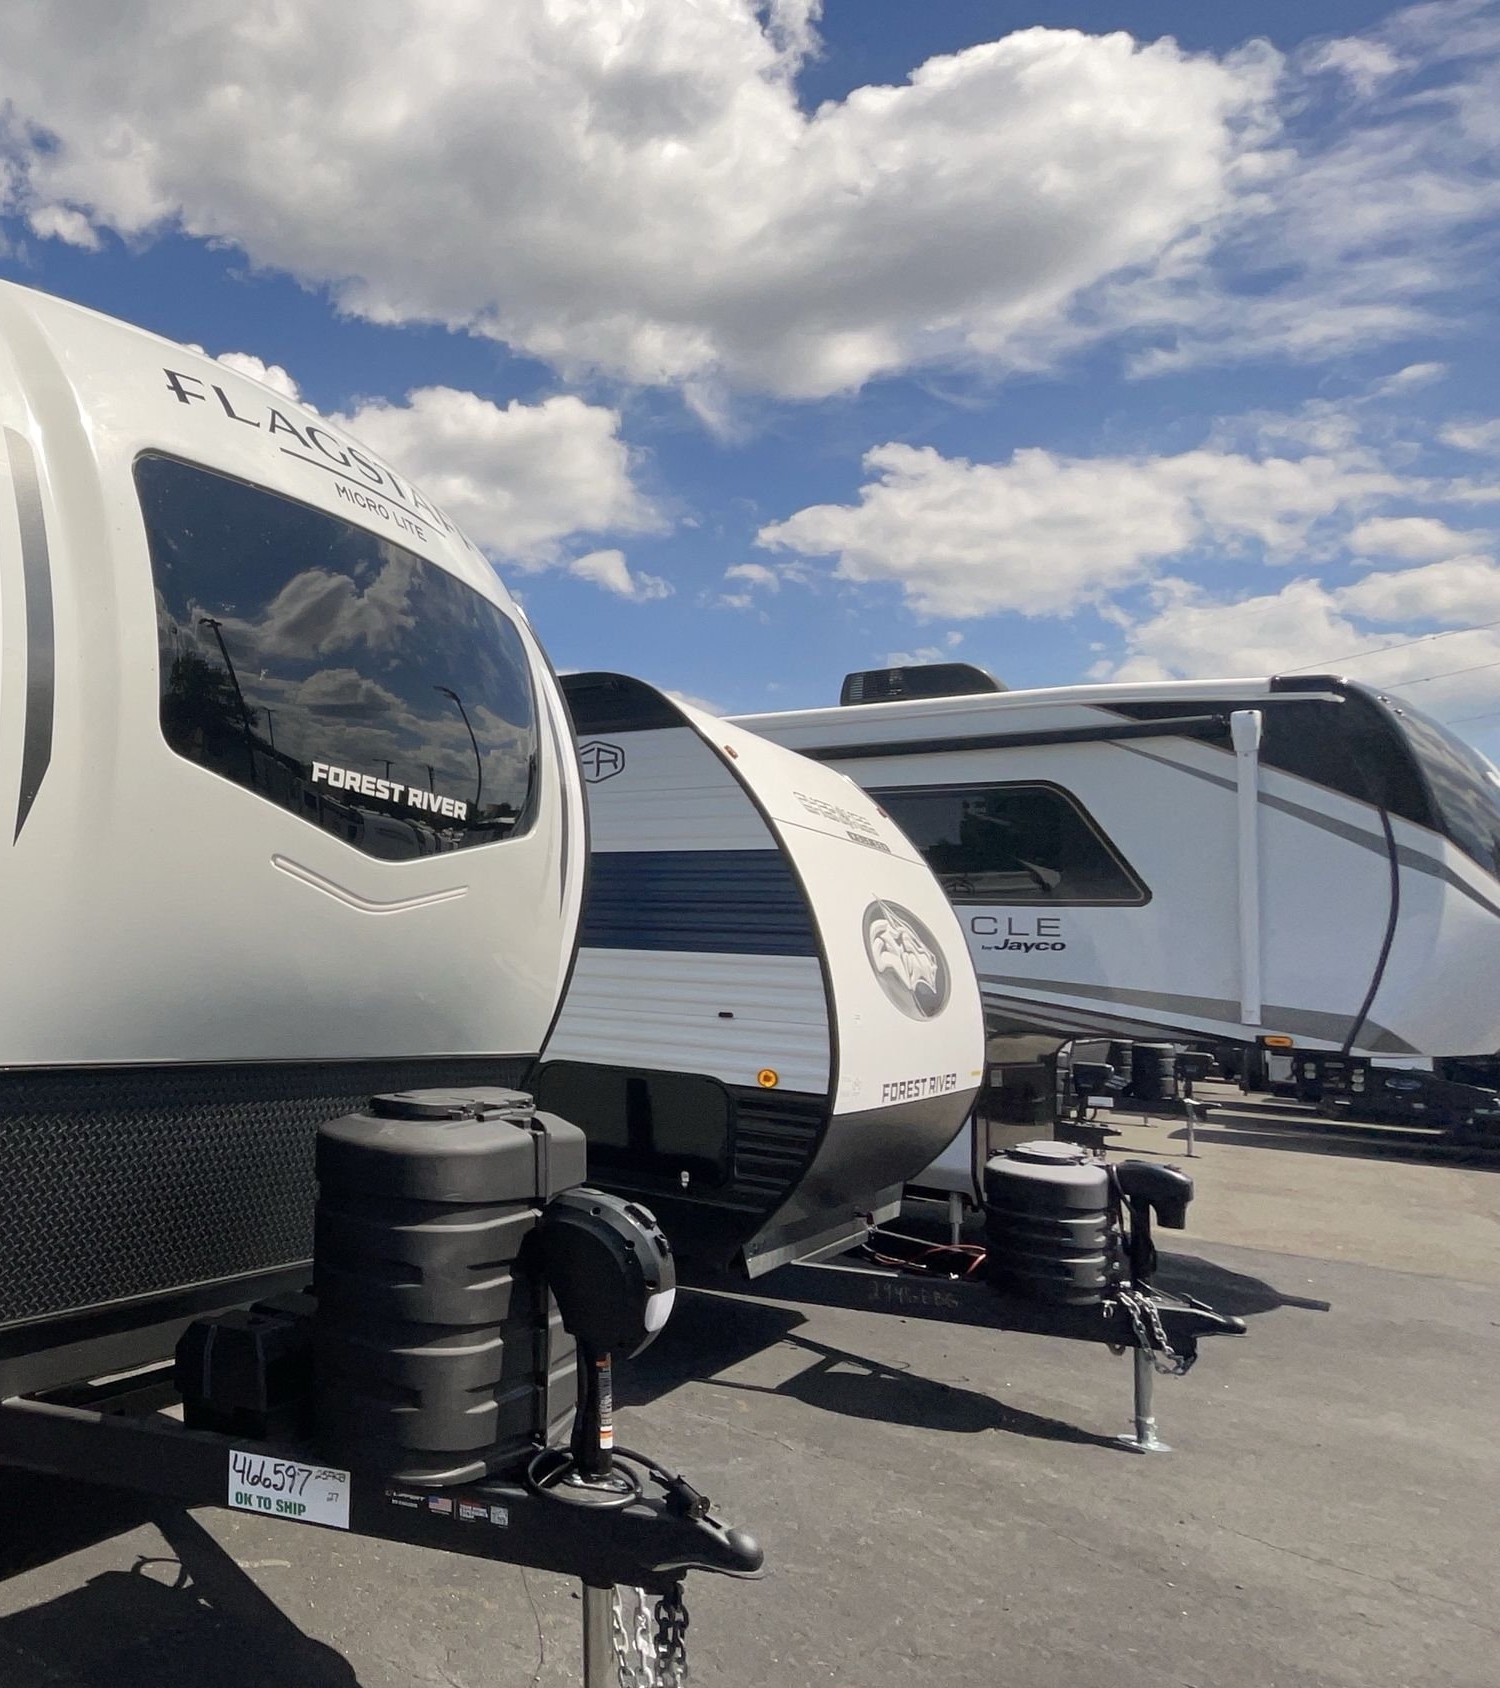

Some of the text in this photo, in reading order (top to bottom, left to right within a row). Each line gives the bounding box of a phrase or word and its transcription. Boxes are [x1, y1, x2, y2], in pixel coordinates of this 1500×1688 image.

[334, 482, 428, 543] MICRO LITE
[310, 760, 468, 821] FOREST RIVER
[994, 938, 1067, 953] Jayco
[881, 1073, 957, 1104] FOREST RIVER
[232, 1452, 313, 1497] 466597
[235, 1490, 307, 1517] OK TO SHIP
